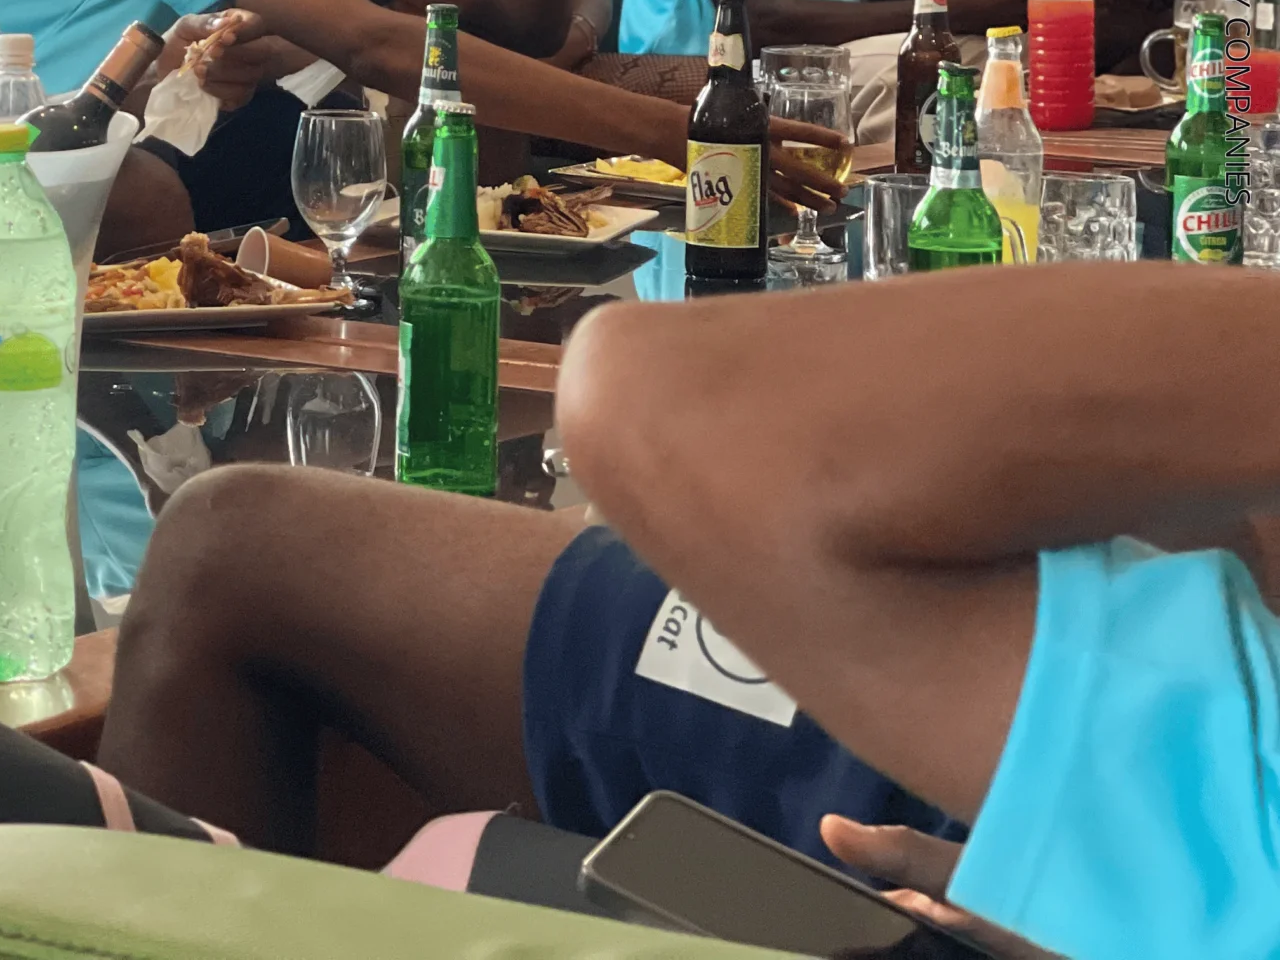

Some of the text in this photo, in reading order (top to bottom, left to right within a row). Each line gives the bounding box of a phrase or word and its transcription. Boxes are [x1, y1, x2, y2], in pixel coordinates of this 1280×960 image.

[1190, 61, 1224, 78] CHIL
[1182, 209, 1239, 233] CHILL
[656, 604, 689, 652] cat
